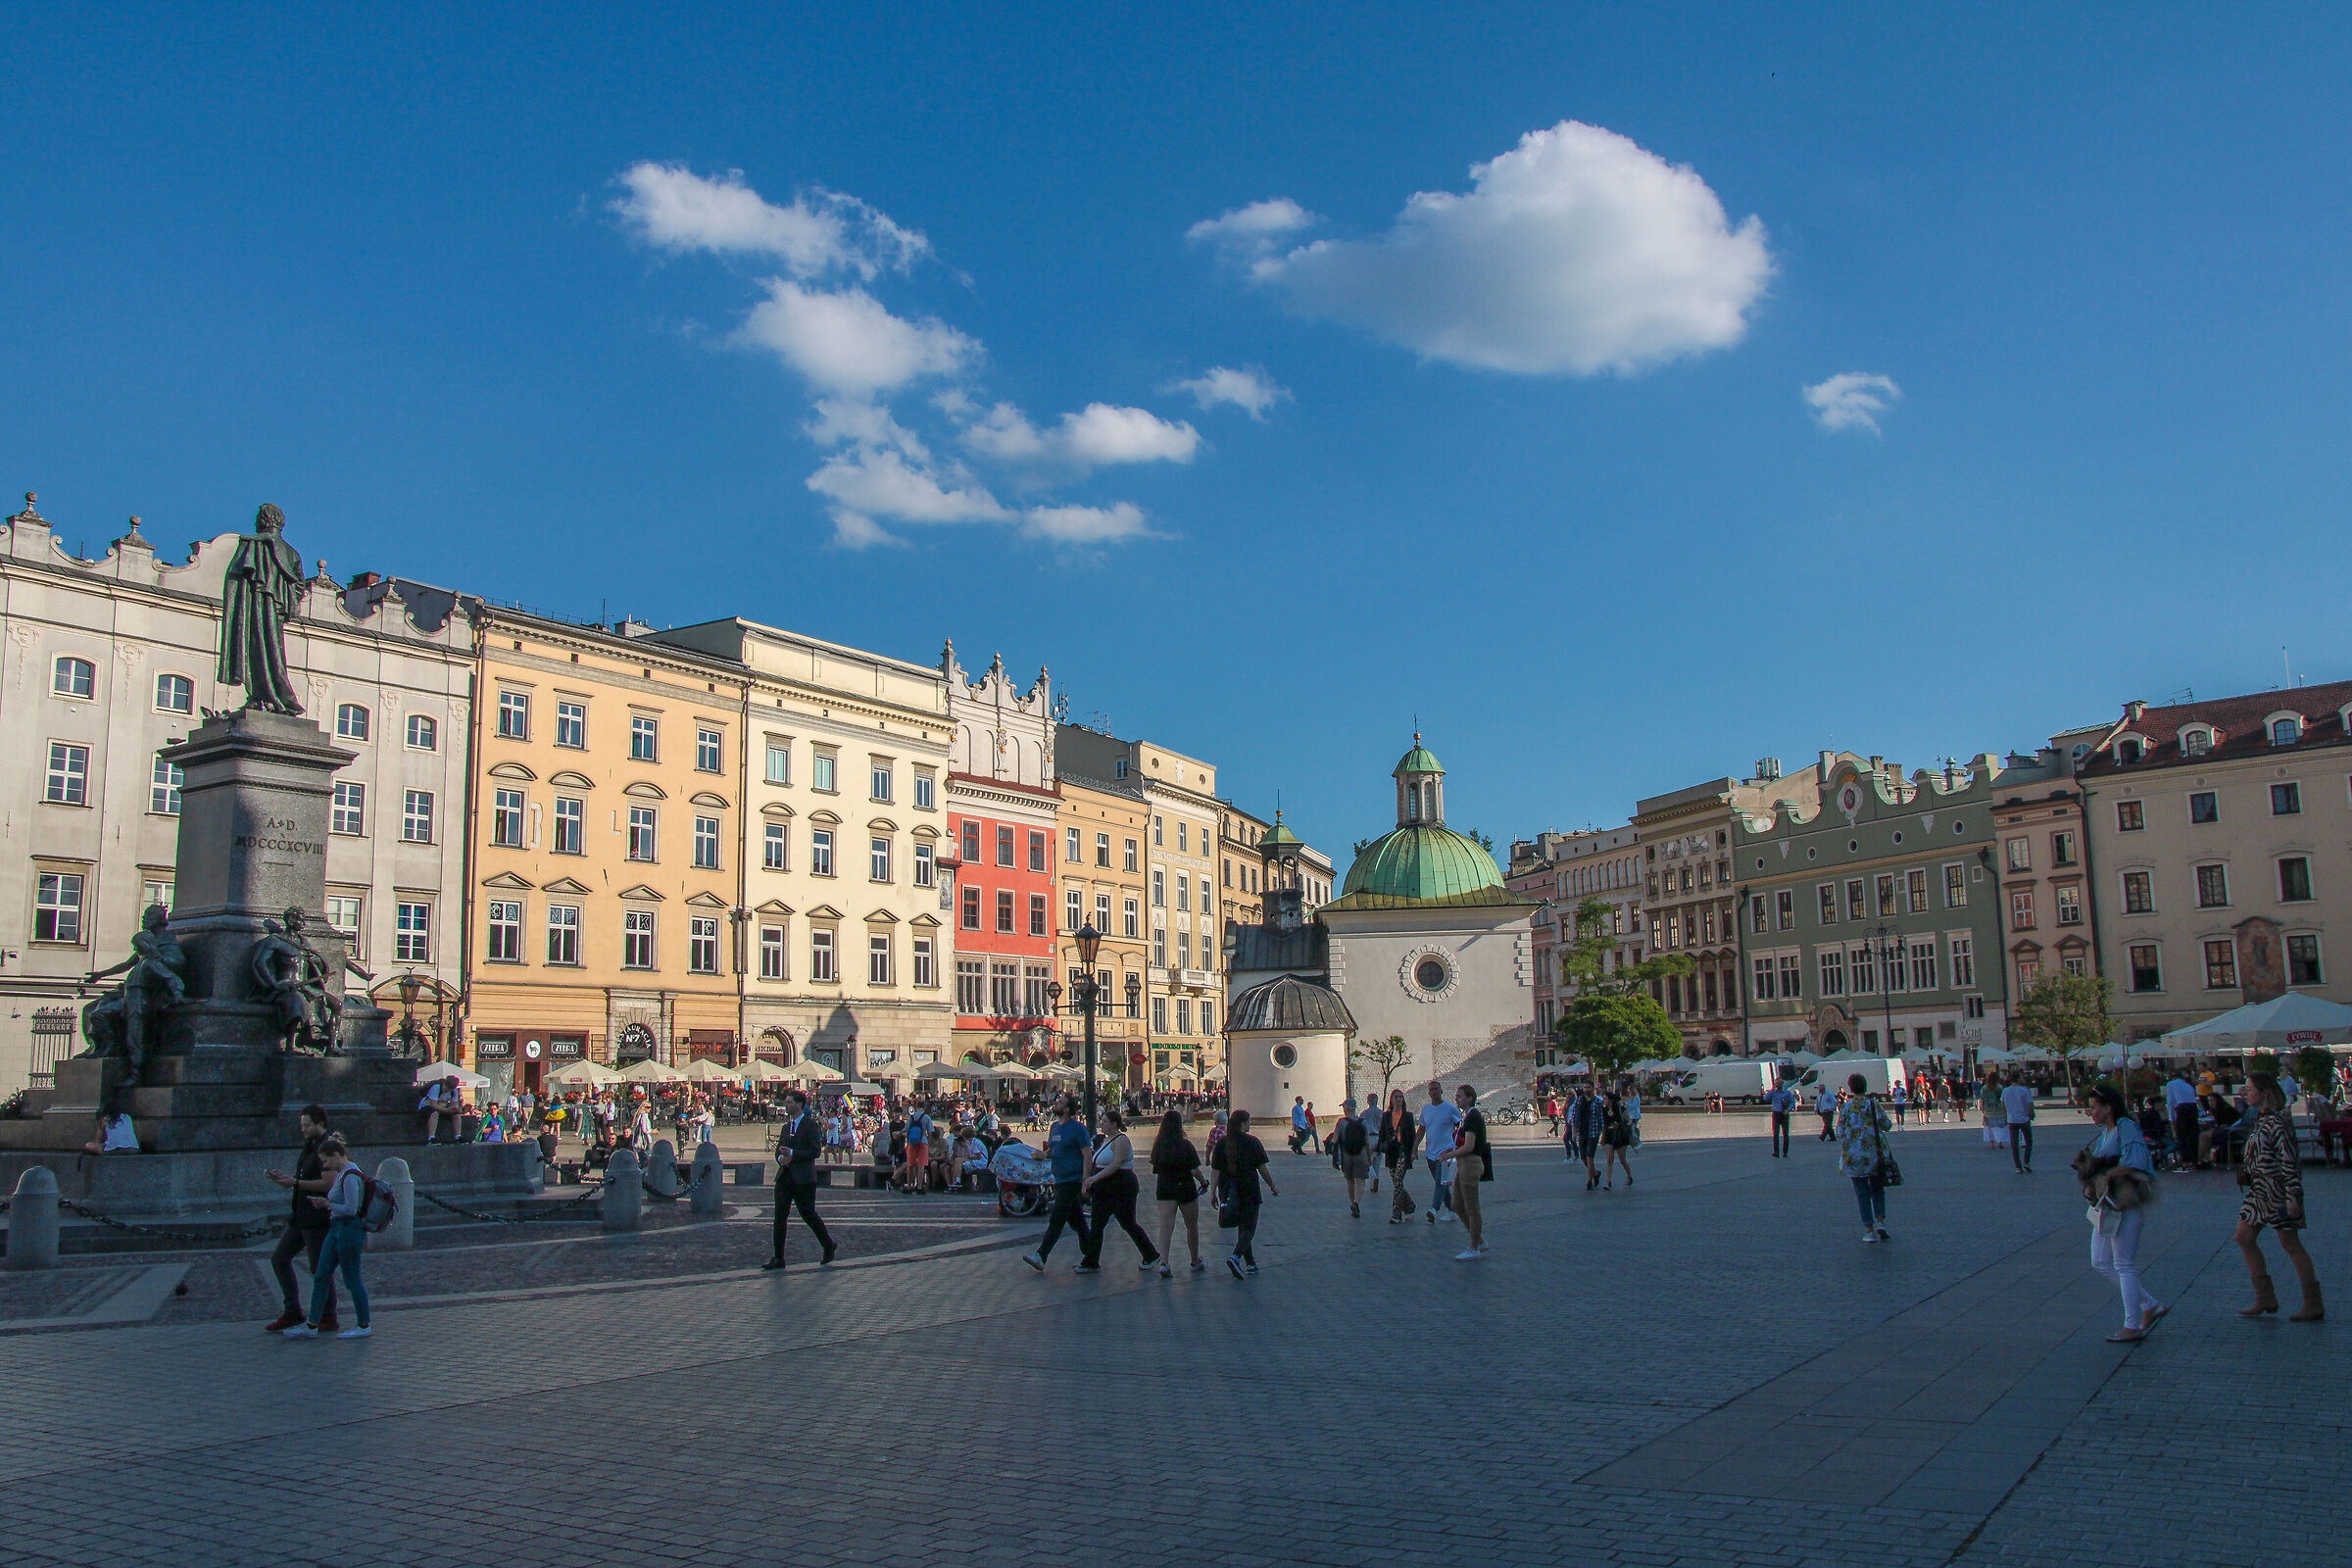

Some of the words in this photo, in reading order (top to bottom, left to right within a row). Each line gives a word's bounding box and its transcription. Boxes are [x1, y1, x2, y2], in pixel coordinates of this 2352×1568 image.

[235, 835, 323, 856] MDCCCXCVIII
[484, 1044, 505, 1053] ZEBRA
[555, 1044, 575, 1053] ZEBRA
